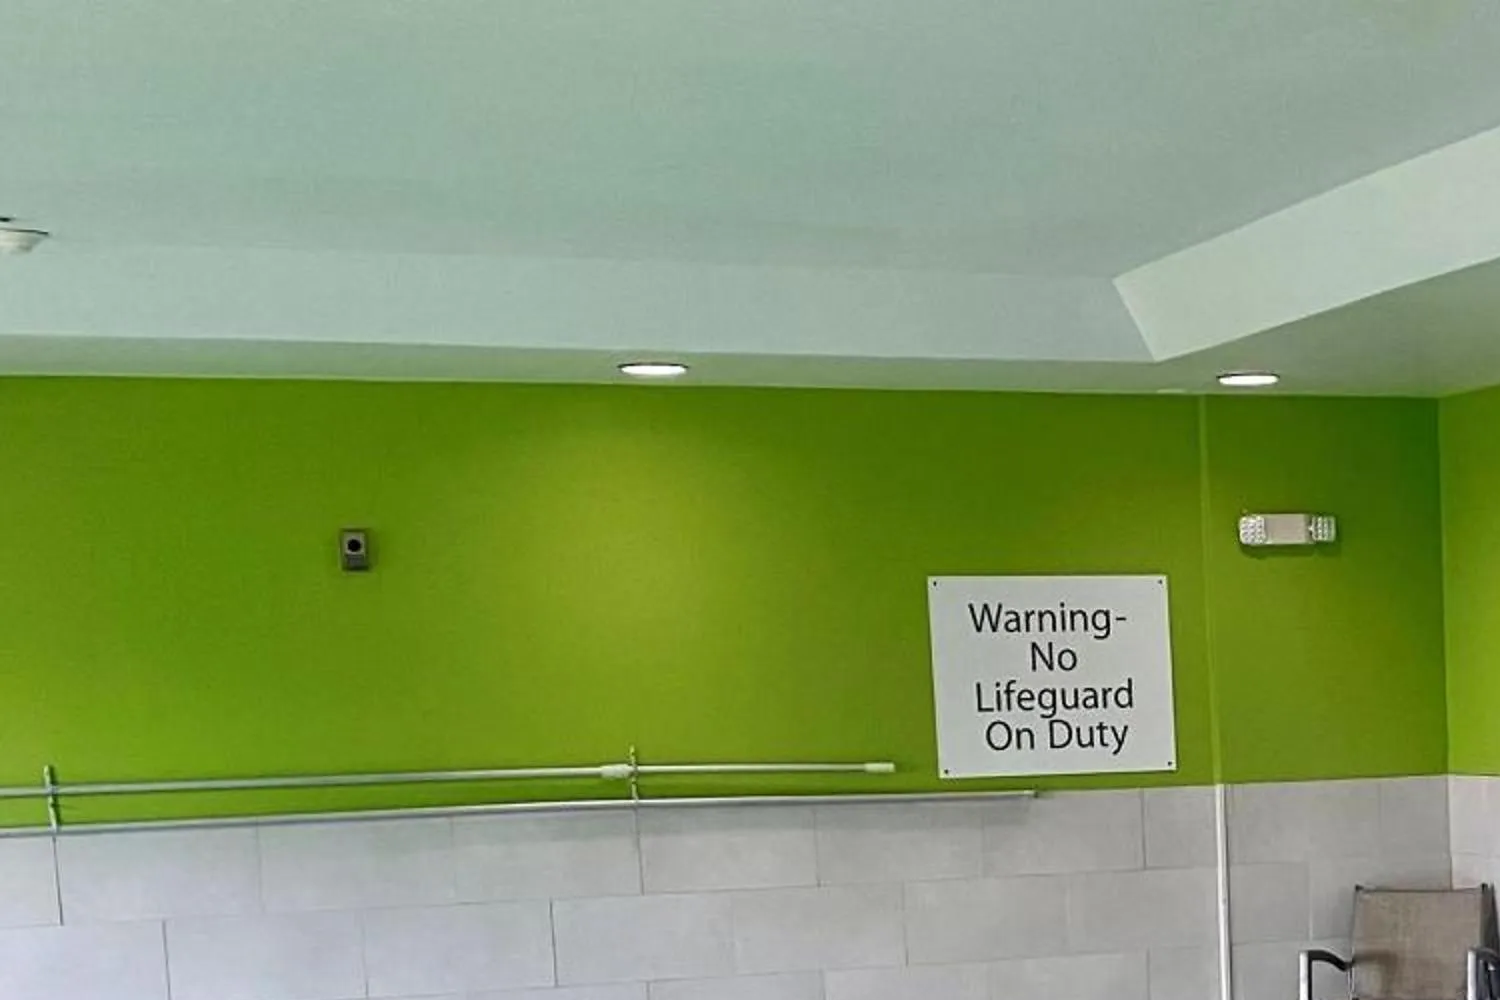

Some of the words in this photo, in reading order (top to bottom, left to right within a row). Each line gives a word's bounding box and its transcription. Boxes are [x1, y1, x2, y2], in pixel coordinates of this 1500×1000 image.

[968, 602, 1127, 640] Warning-
[1031, 642, 1078, 672] No
[976, 678, 1133, 718] Lifeguard
[985, 720, 1036, 751] On
[1049, 719, 1129, 755] Duty
